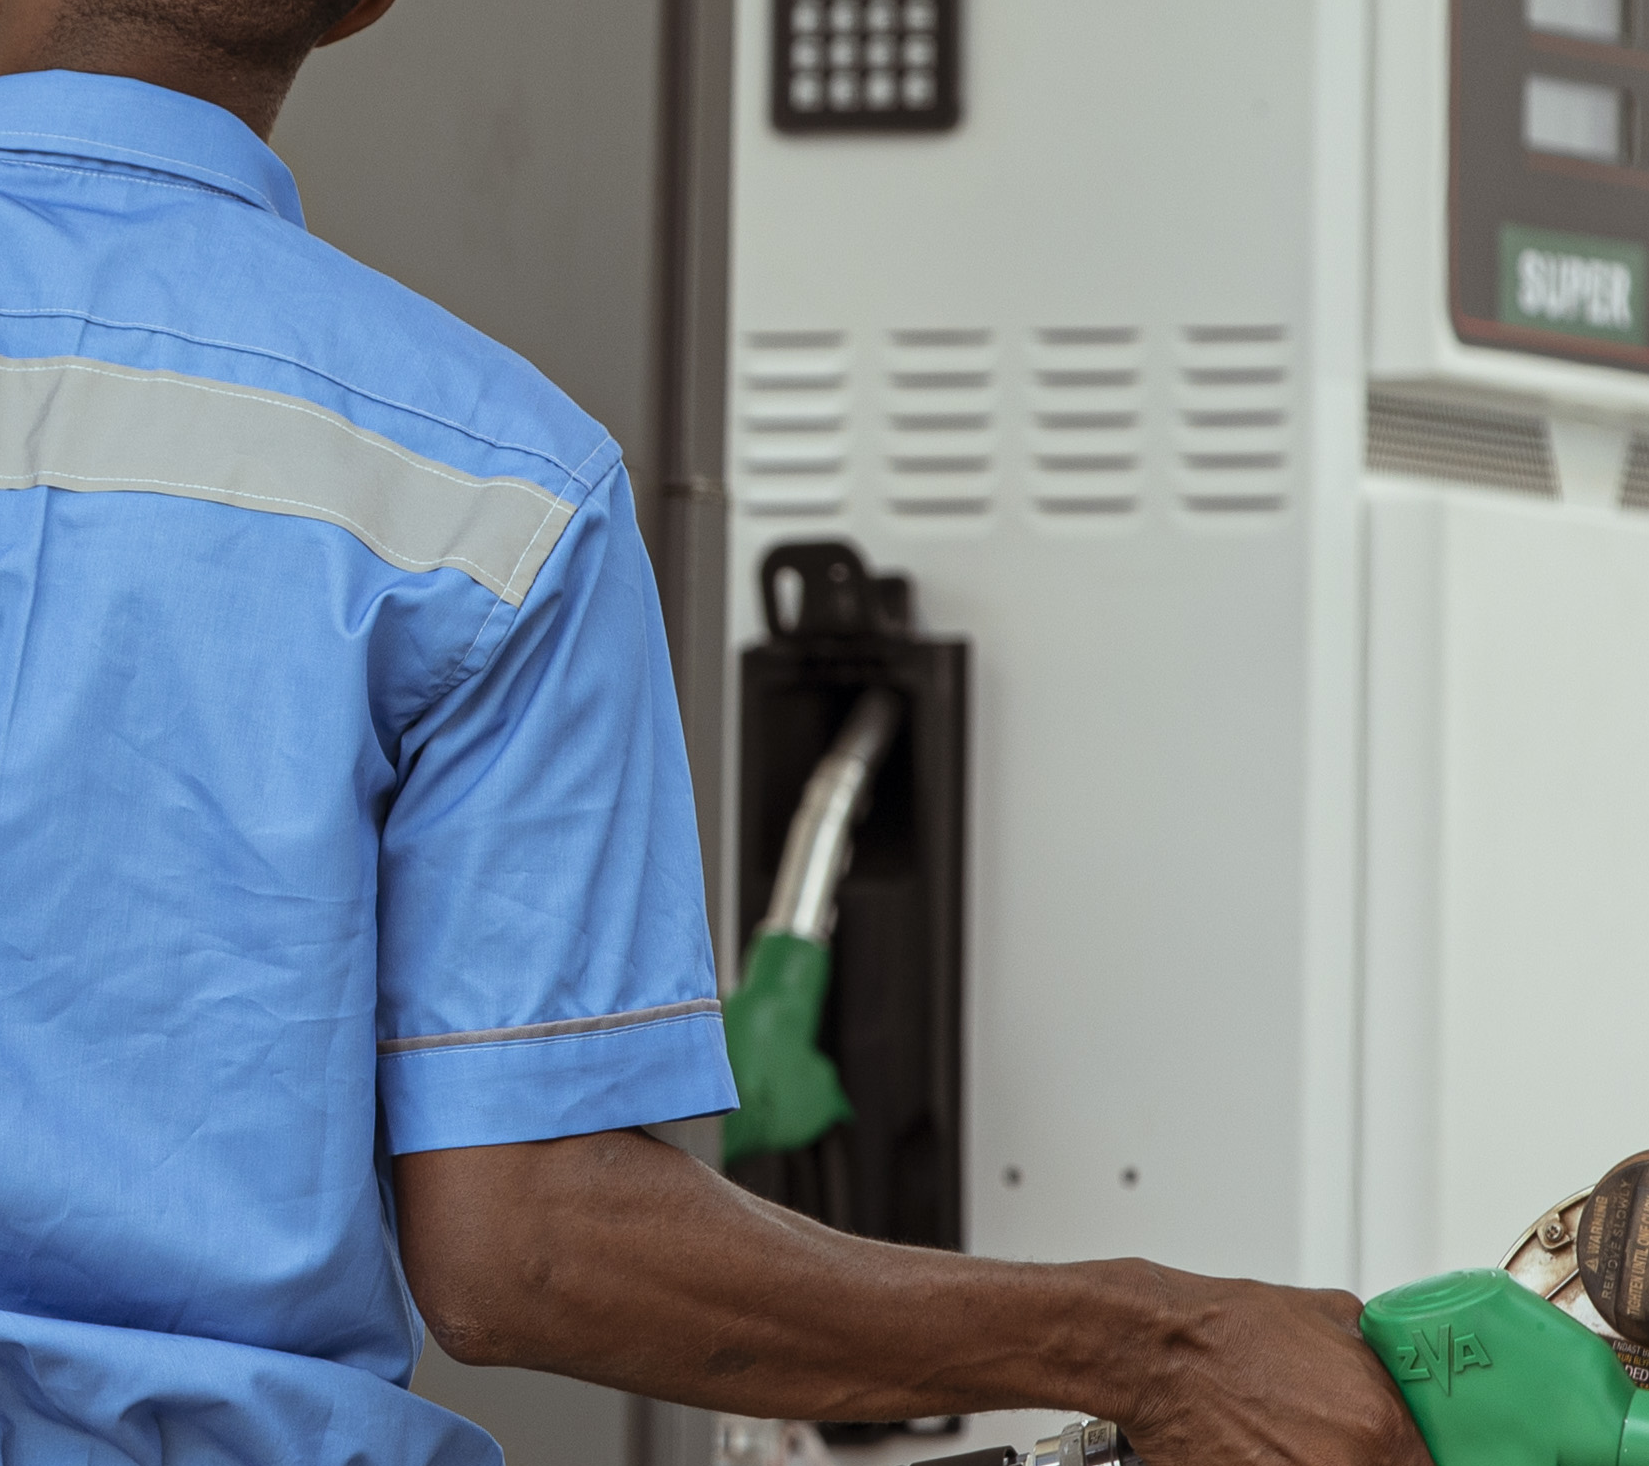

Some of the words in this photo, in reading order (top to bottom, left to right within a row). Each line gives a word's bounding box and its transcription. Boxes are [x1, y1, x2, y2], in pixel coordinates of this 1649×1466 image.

[1516, 247, 1633, 331] SUPER
[1587, 1195, 1608, 1254] WARNING
[1602, 1241, 1622, 1300] REMOVE
[1614, 1181, 1632, 1238] SLOWLY
[1632, 1247, 1649, 1275] UNTIL
[1627, 1274, 1645, 1315] TIGHTEN
